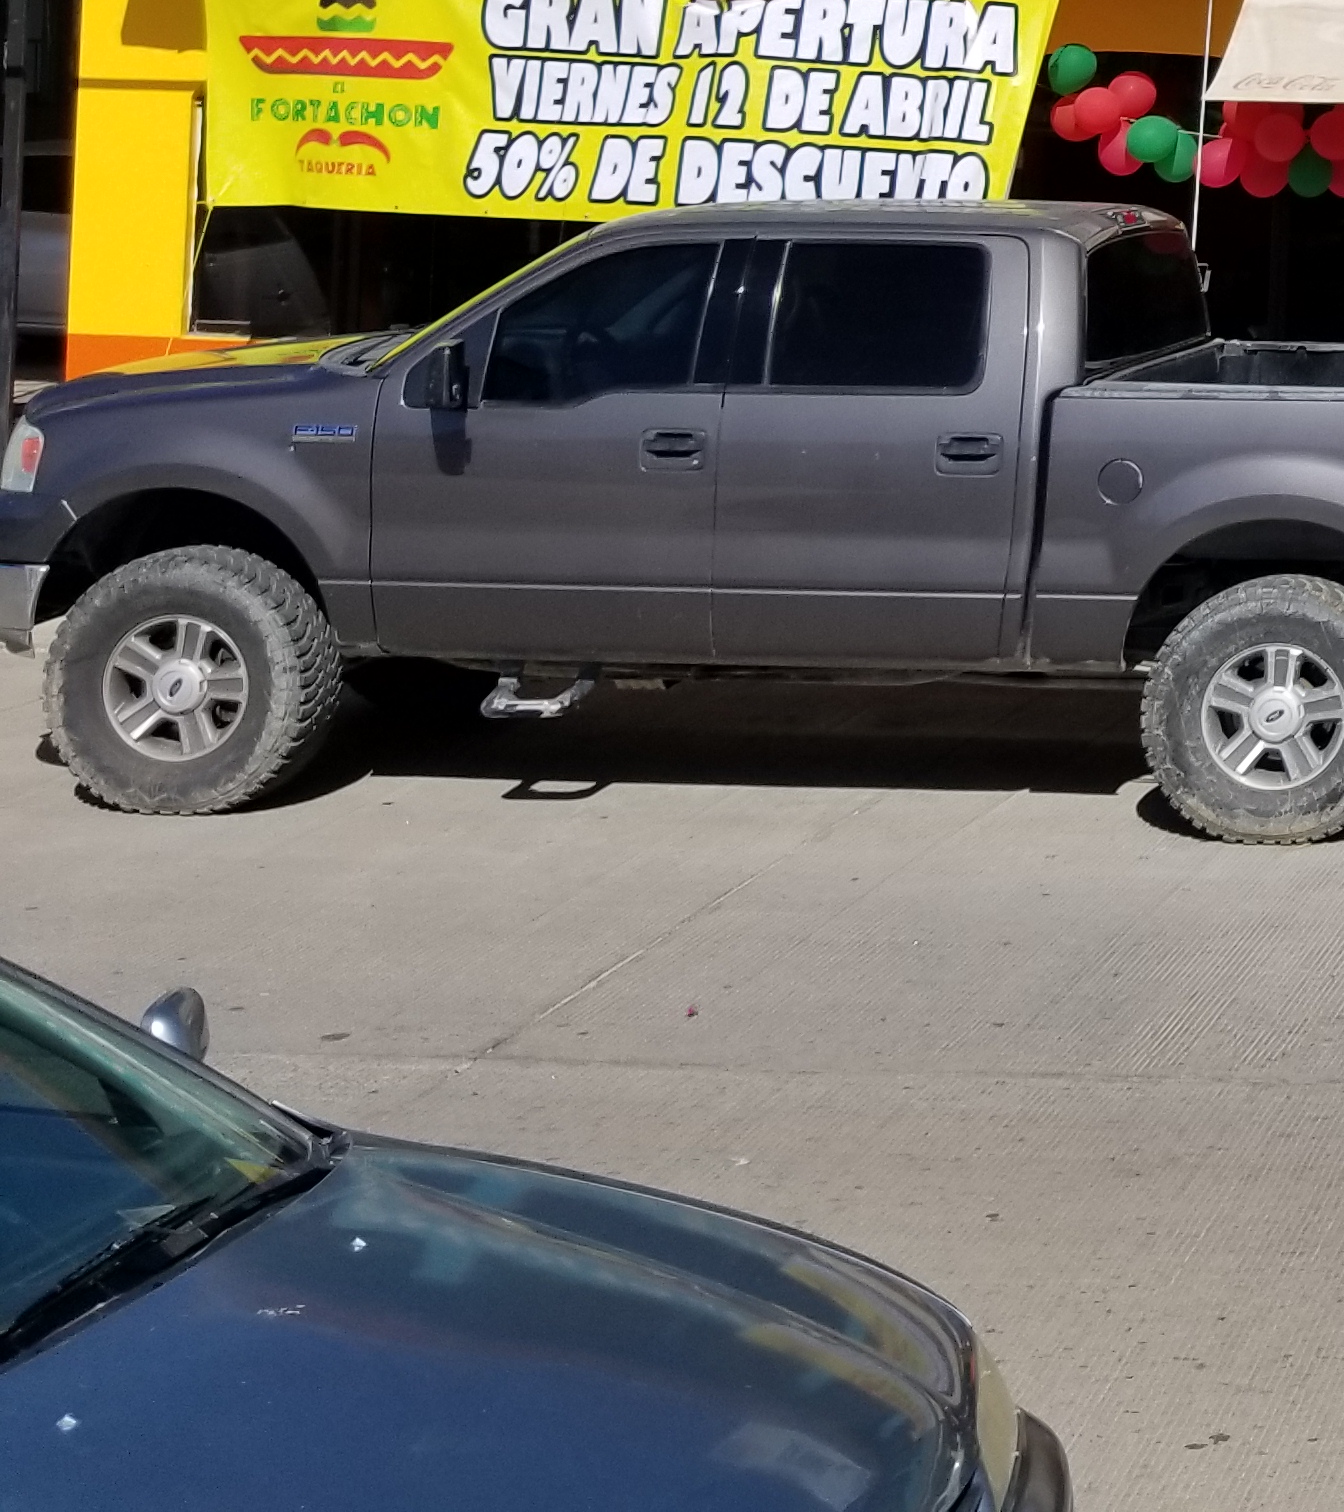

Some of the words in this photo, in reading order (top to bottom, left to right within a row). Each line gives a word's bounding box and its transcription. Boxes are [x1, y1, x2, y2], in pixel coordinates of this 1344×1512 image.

[250, 97, 440, 129] FORTACHON
[488, 53, 683, 127] VIERNES
[687, 60, 750, 129] 12
[762, 65, 840, 134] DE
[840, 71, 994, 144] ABRIL
[298, 159, 377, 176] TAQUERIA
[463, 129, 580, 202] 50%
[588, 134, 668, 206] DE
[675, 135, 990, 206] DESCUENTO
